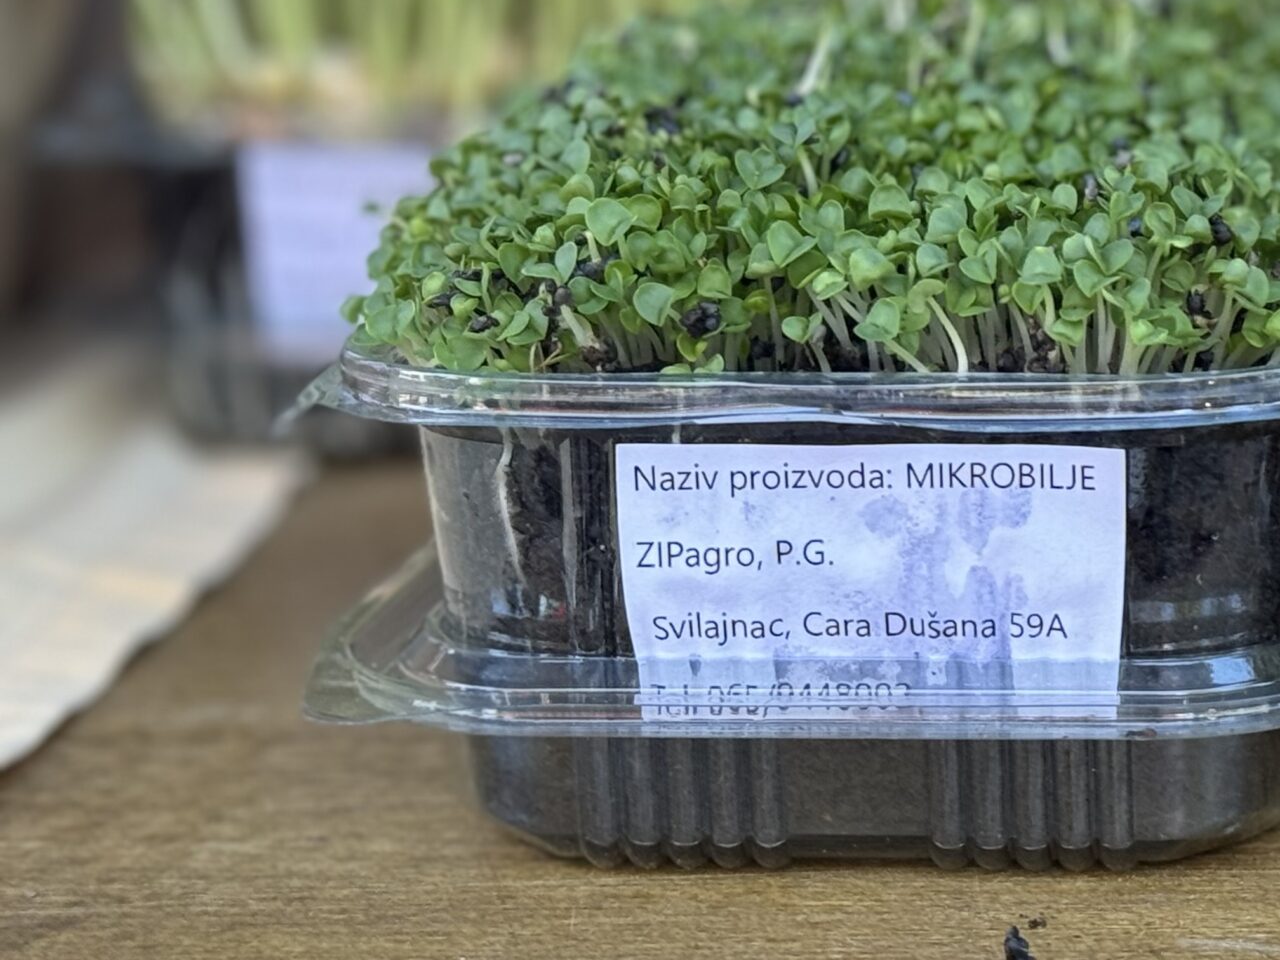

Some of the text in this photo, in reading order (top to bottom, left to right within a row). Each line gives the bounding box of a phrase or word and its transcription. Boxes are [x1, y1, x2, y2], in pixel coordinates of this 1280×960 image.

[633, 461, 1096, 498] Naziv proizvoda: MIKROBILJE
[635, 538, 834, 576] ZIPagro, P.G.
[652, 610, 1068, 647] Svilajnac, Cara Dušana 59A
